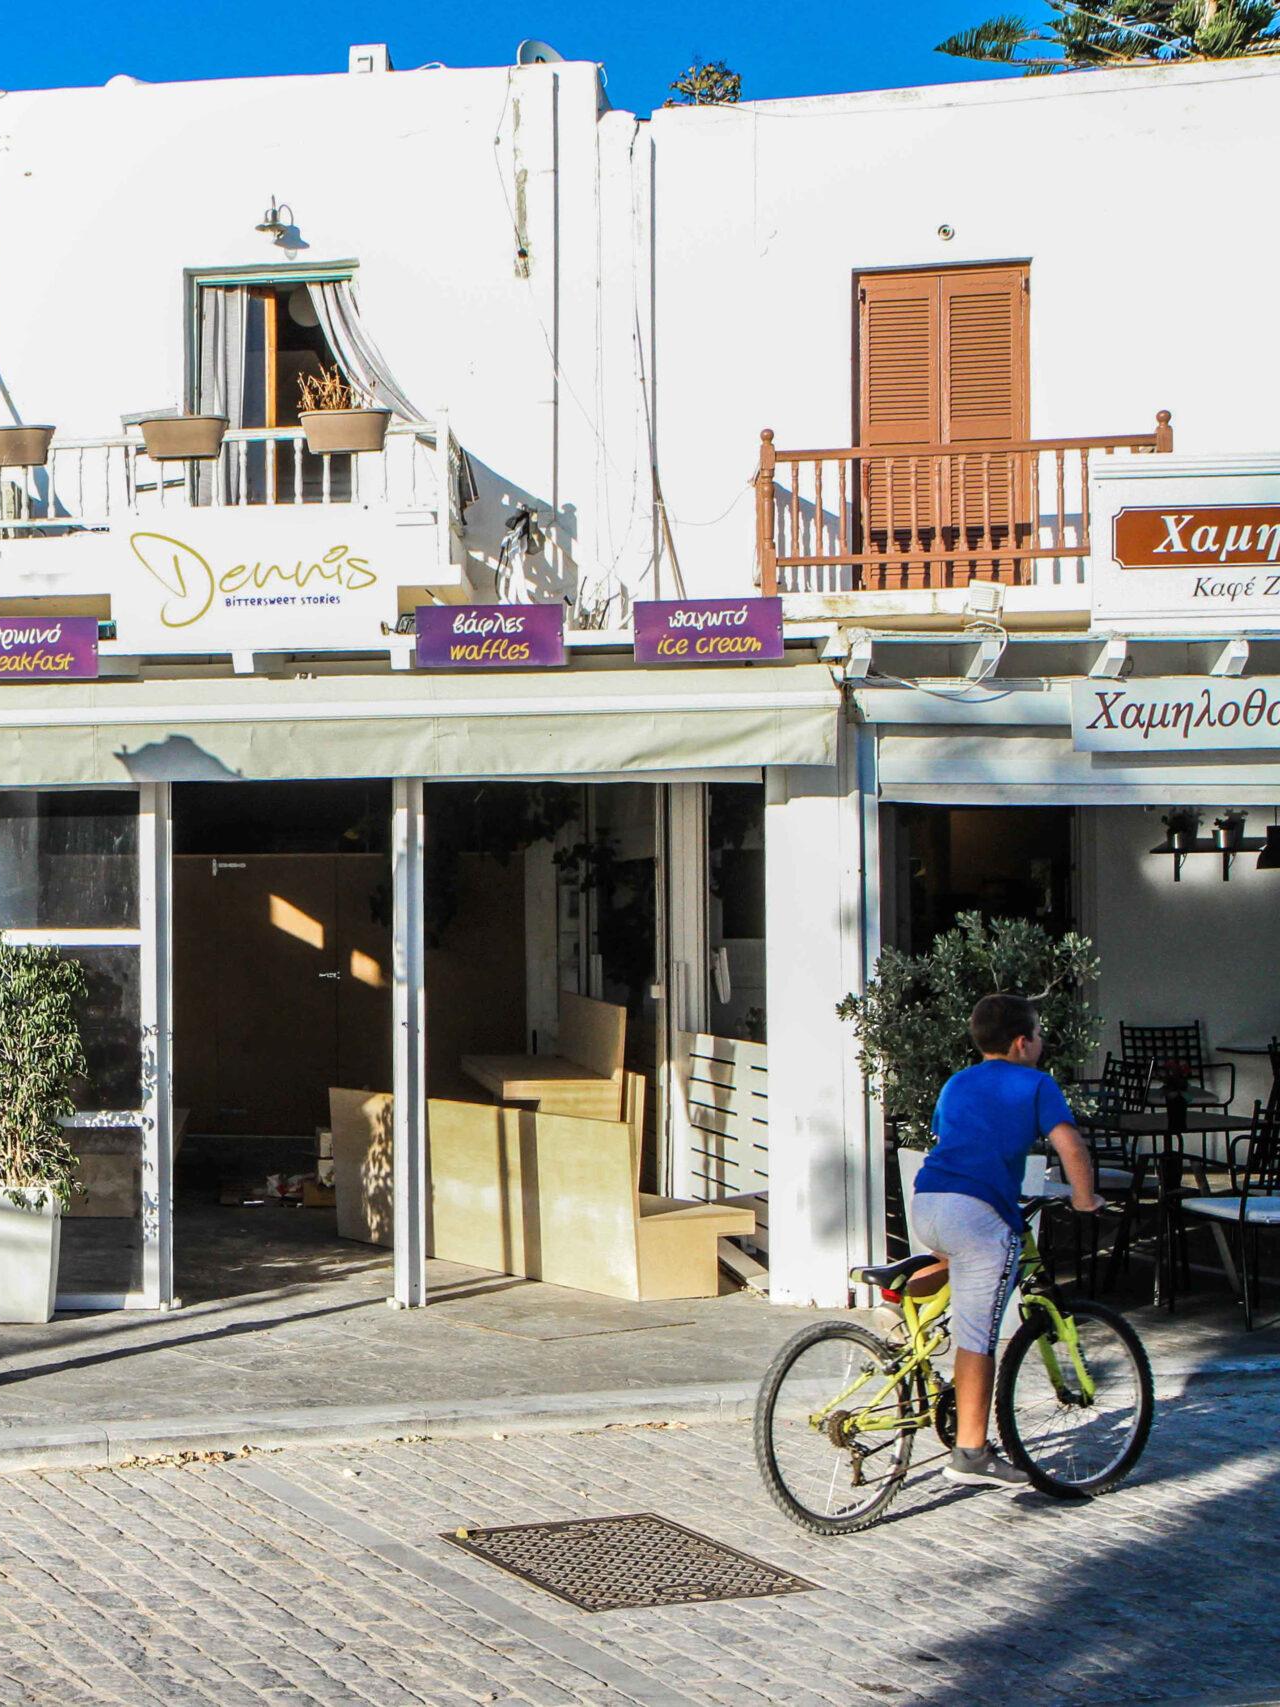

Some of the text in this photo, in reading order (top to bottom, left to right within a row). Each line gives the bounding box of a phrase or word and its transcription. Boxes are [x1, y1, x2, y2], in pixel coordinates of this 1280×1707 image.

[129, 531, 378, 628] Dennis
[1192, 576, 1257, 602] Καφέ
[452, 611, 526, 637] βάφλες
[668, 604, 748, 631] παγωτό
[449, 639, 530, 661] waffles
[656, 633, 762, 655] ice cream
